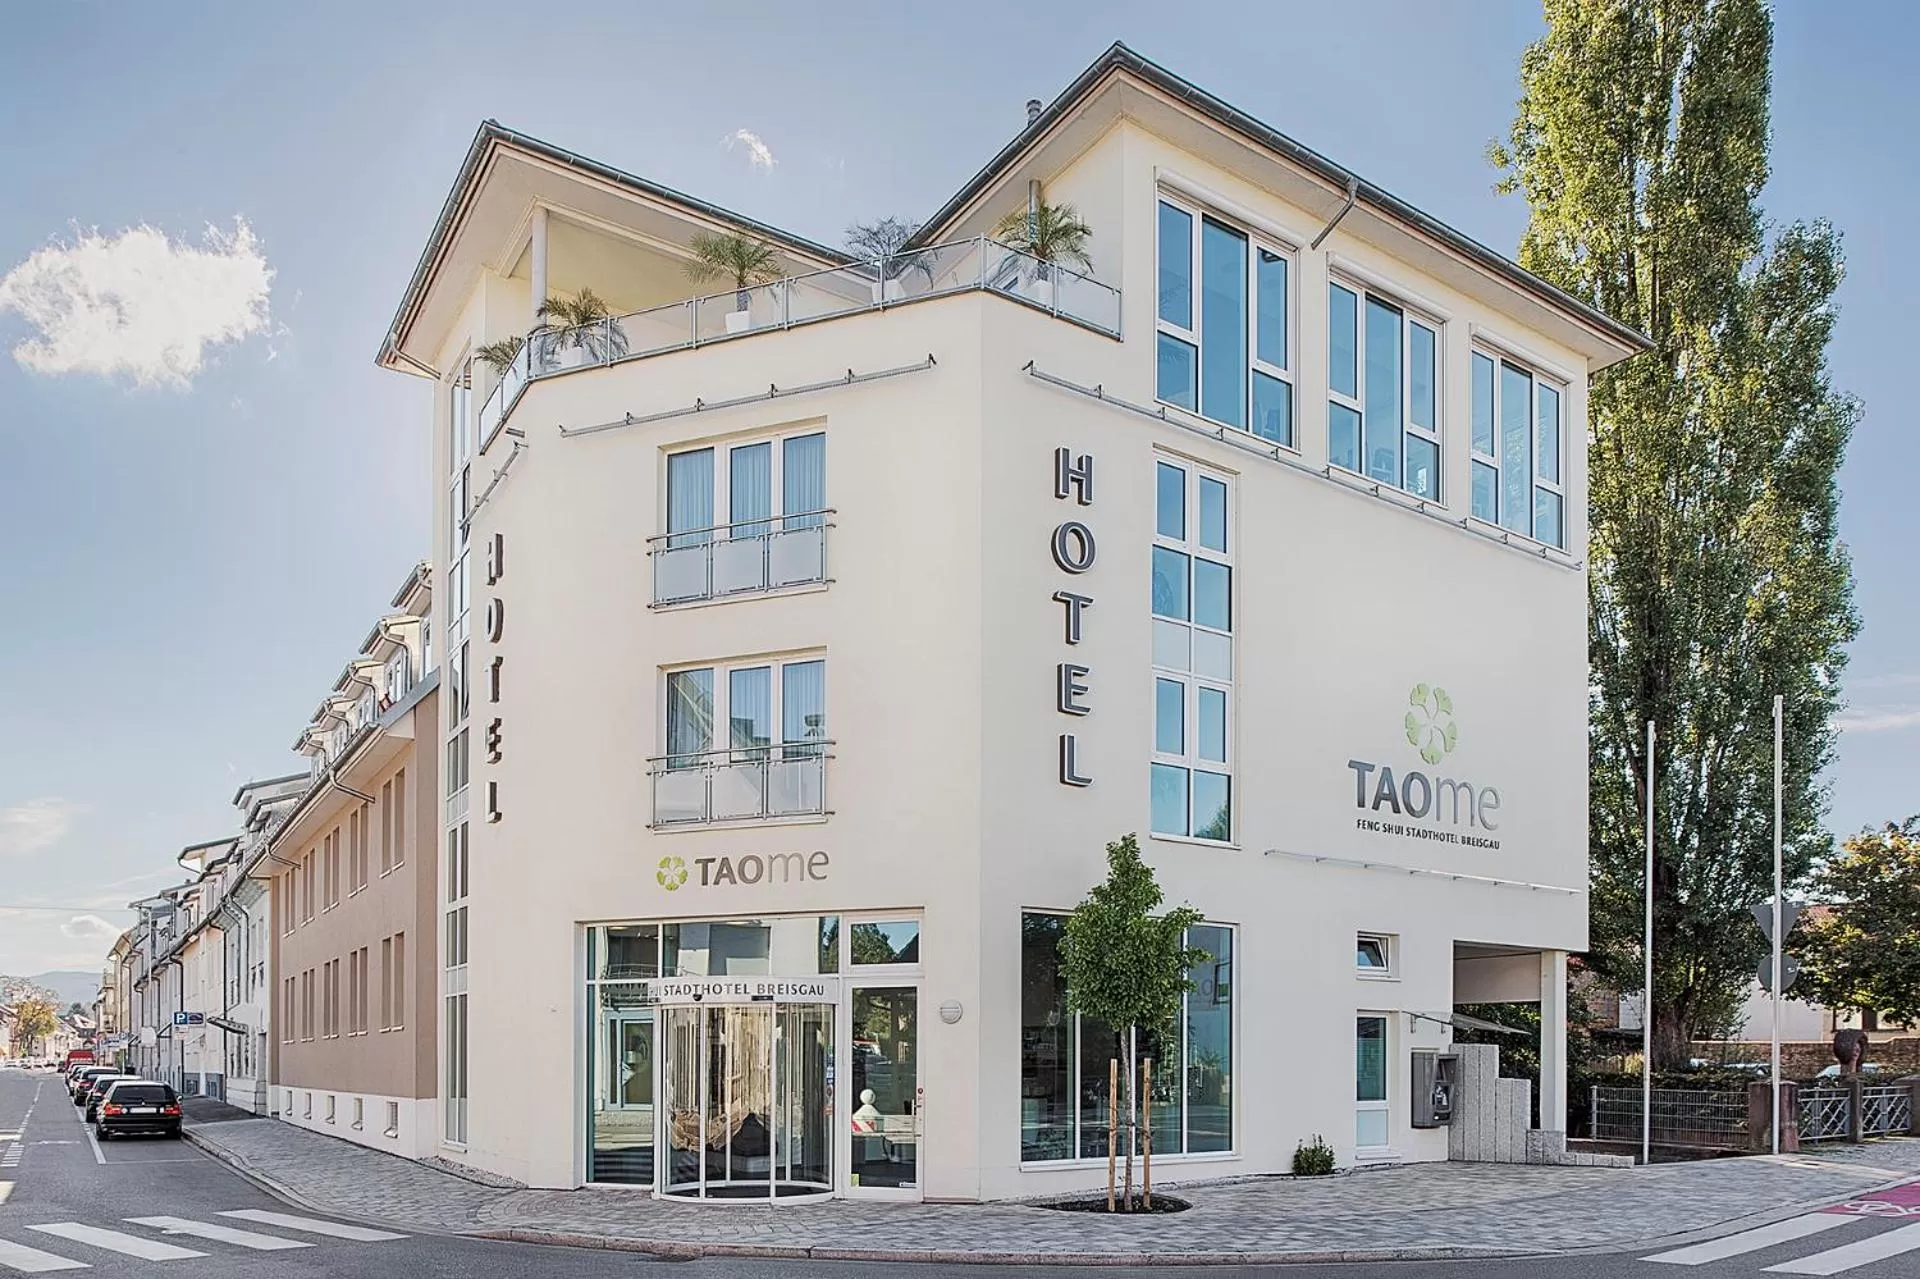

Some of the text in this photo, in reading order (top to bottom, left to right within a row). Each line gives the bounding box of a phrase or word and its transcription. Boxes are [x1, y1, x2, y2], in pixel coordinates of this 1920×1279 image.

[1050, 446, 1096, 787] HOTEL
[1348, 759, 1500, 831] TAOme
[1357, 818, 1500, 850] FENG SHUI STADTHOTEL BREISGAU
[694, 850, 830, 887] TAOme
[663, 983, 750, 996] STADTHOTEL
[757, 983, 825, 996] BREISGAU
[176, 1013, 186, 1024] P
